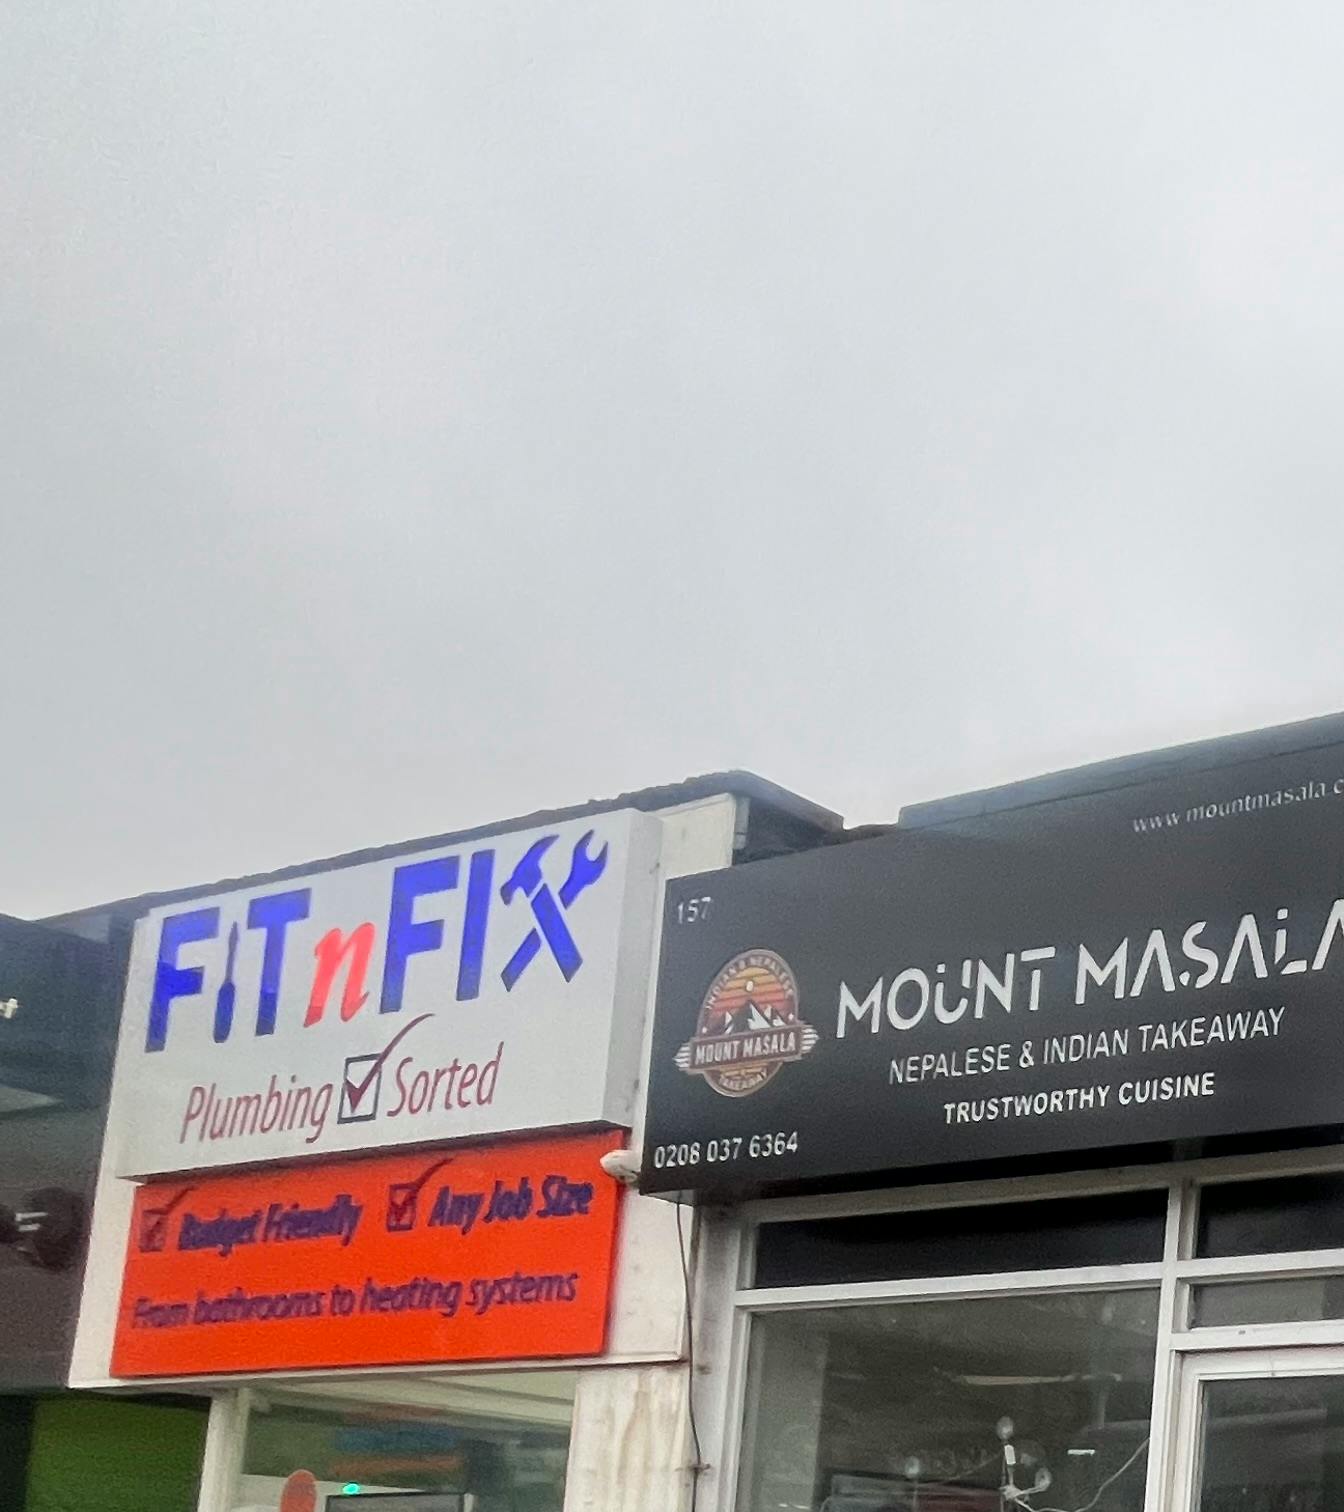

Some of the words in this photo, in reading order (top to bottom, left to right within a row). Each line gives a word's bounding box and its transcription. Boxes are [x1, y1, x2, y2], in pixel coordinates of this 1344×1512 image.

[678, 896, 711, 924] 157
[836, 946, 1056, 1038] MOUNT
[695, 1040, 741, 1065] MOUNT
[743, 1031, 796, 1058] MASALA
[890, 1039, 1010, 1085] NEPALESE
[1019, 1039, 1035, 1067] &
[1043, 1028, 1129, 1065] INDIAN
[1138, 1007, 1286, 1052] TAKEAWAY
[180, 1075, 333, 1144] Plumbing
[387, 1041, 504, 1116] Sorted
[944, 1085, 1111, 1124] TRUSTWORTHY
[1118, 1071, 1216, 1105] CUISINE
[654, 1142, 701, 1168] 0208
[706, 1137, 743, 1162] 037
[749, 1131, 798, 1157] 6364
[262, 1194, 364, 1246] Friendly
[427, 1185, 484, 1235] Any
[484, 1176, 533, 1224] Job
[537, 1175, 594, 1218] Size
[132, 1296, 188, 1329] From
[194, 1286, 327, 1325] bathrooms
[330, 1285, 356, 1316] to
[360, 1278, 463, 1317] heating
[469, 1272, 578, 1315] systems
